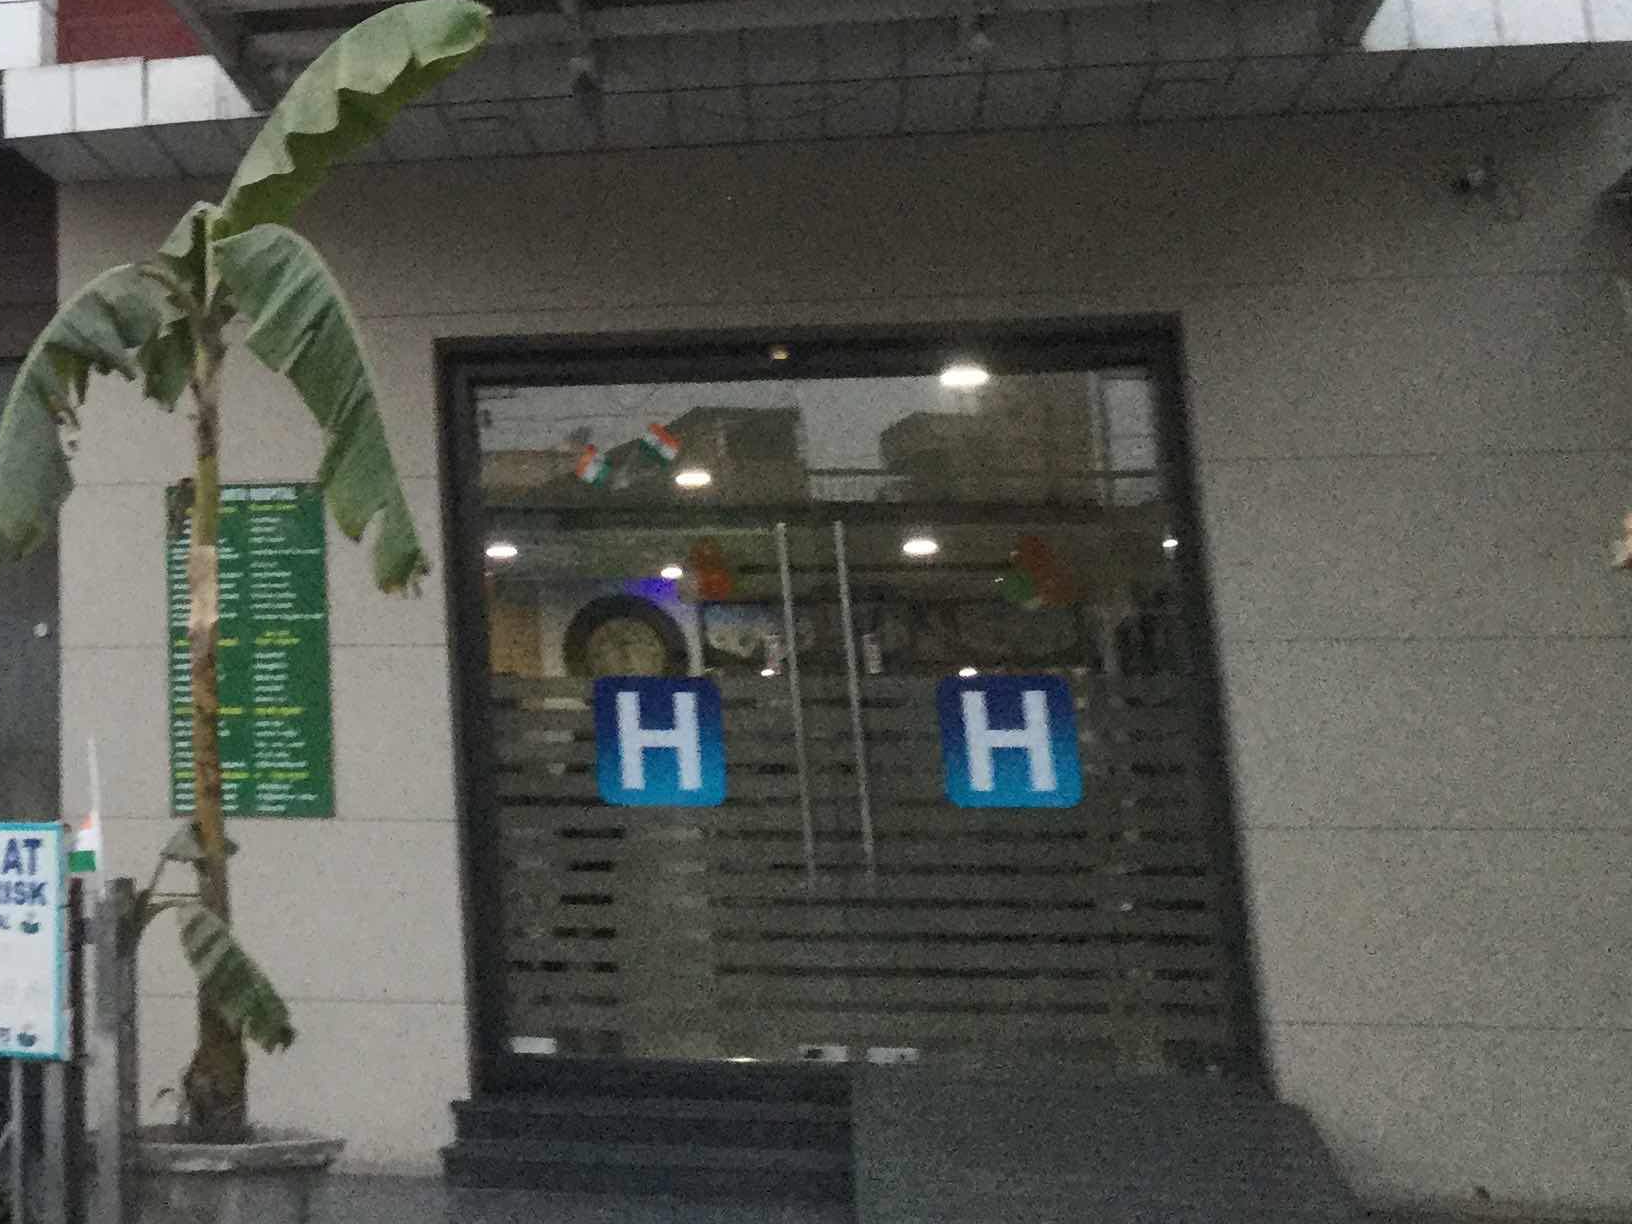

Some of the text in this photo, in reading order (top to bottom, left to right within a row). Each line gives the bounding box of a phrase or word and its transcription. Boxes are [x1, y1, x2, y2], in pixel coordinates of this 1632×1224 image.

[615, 690, 705, 792] H
[959, 689, 1058, 793] H
[1, 838, 43, 875] AT
